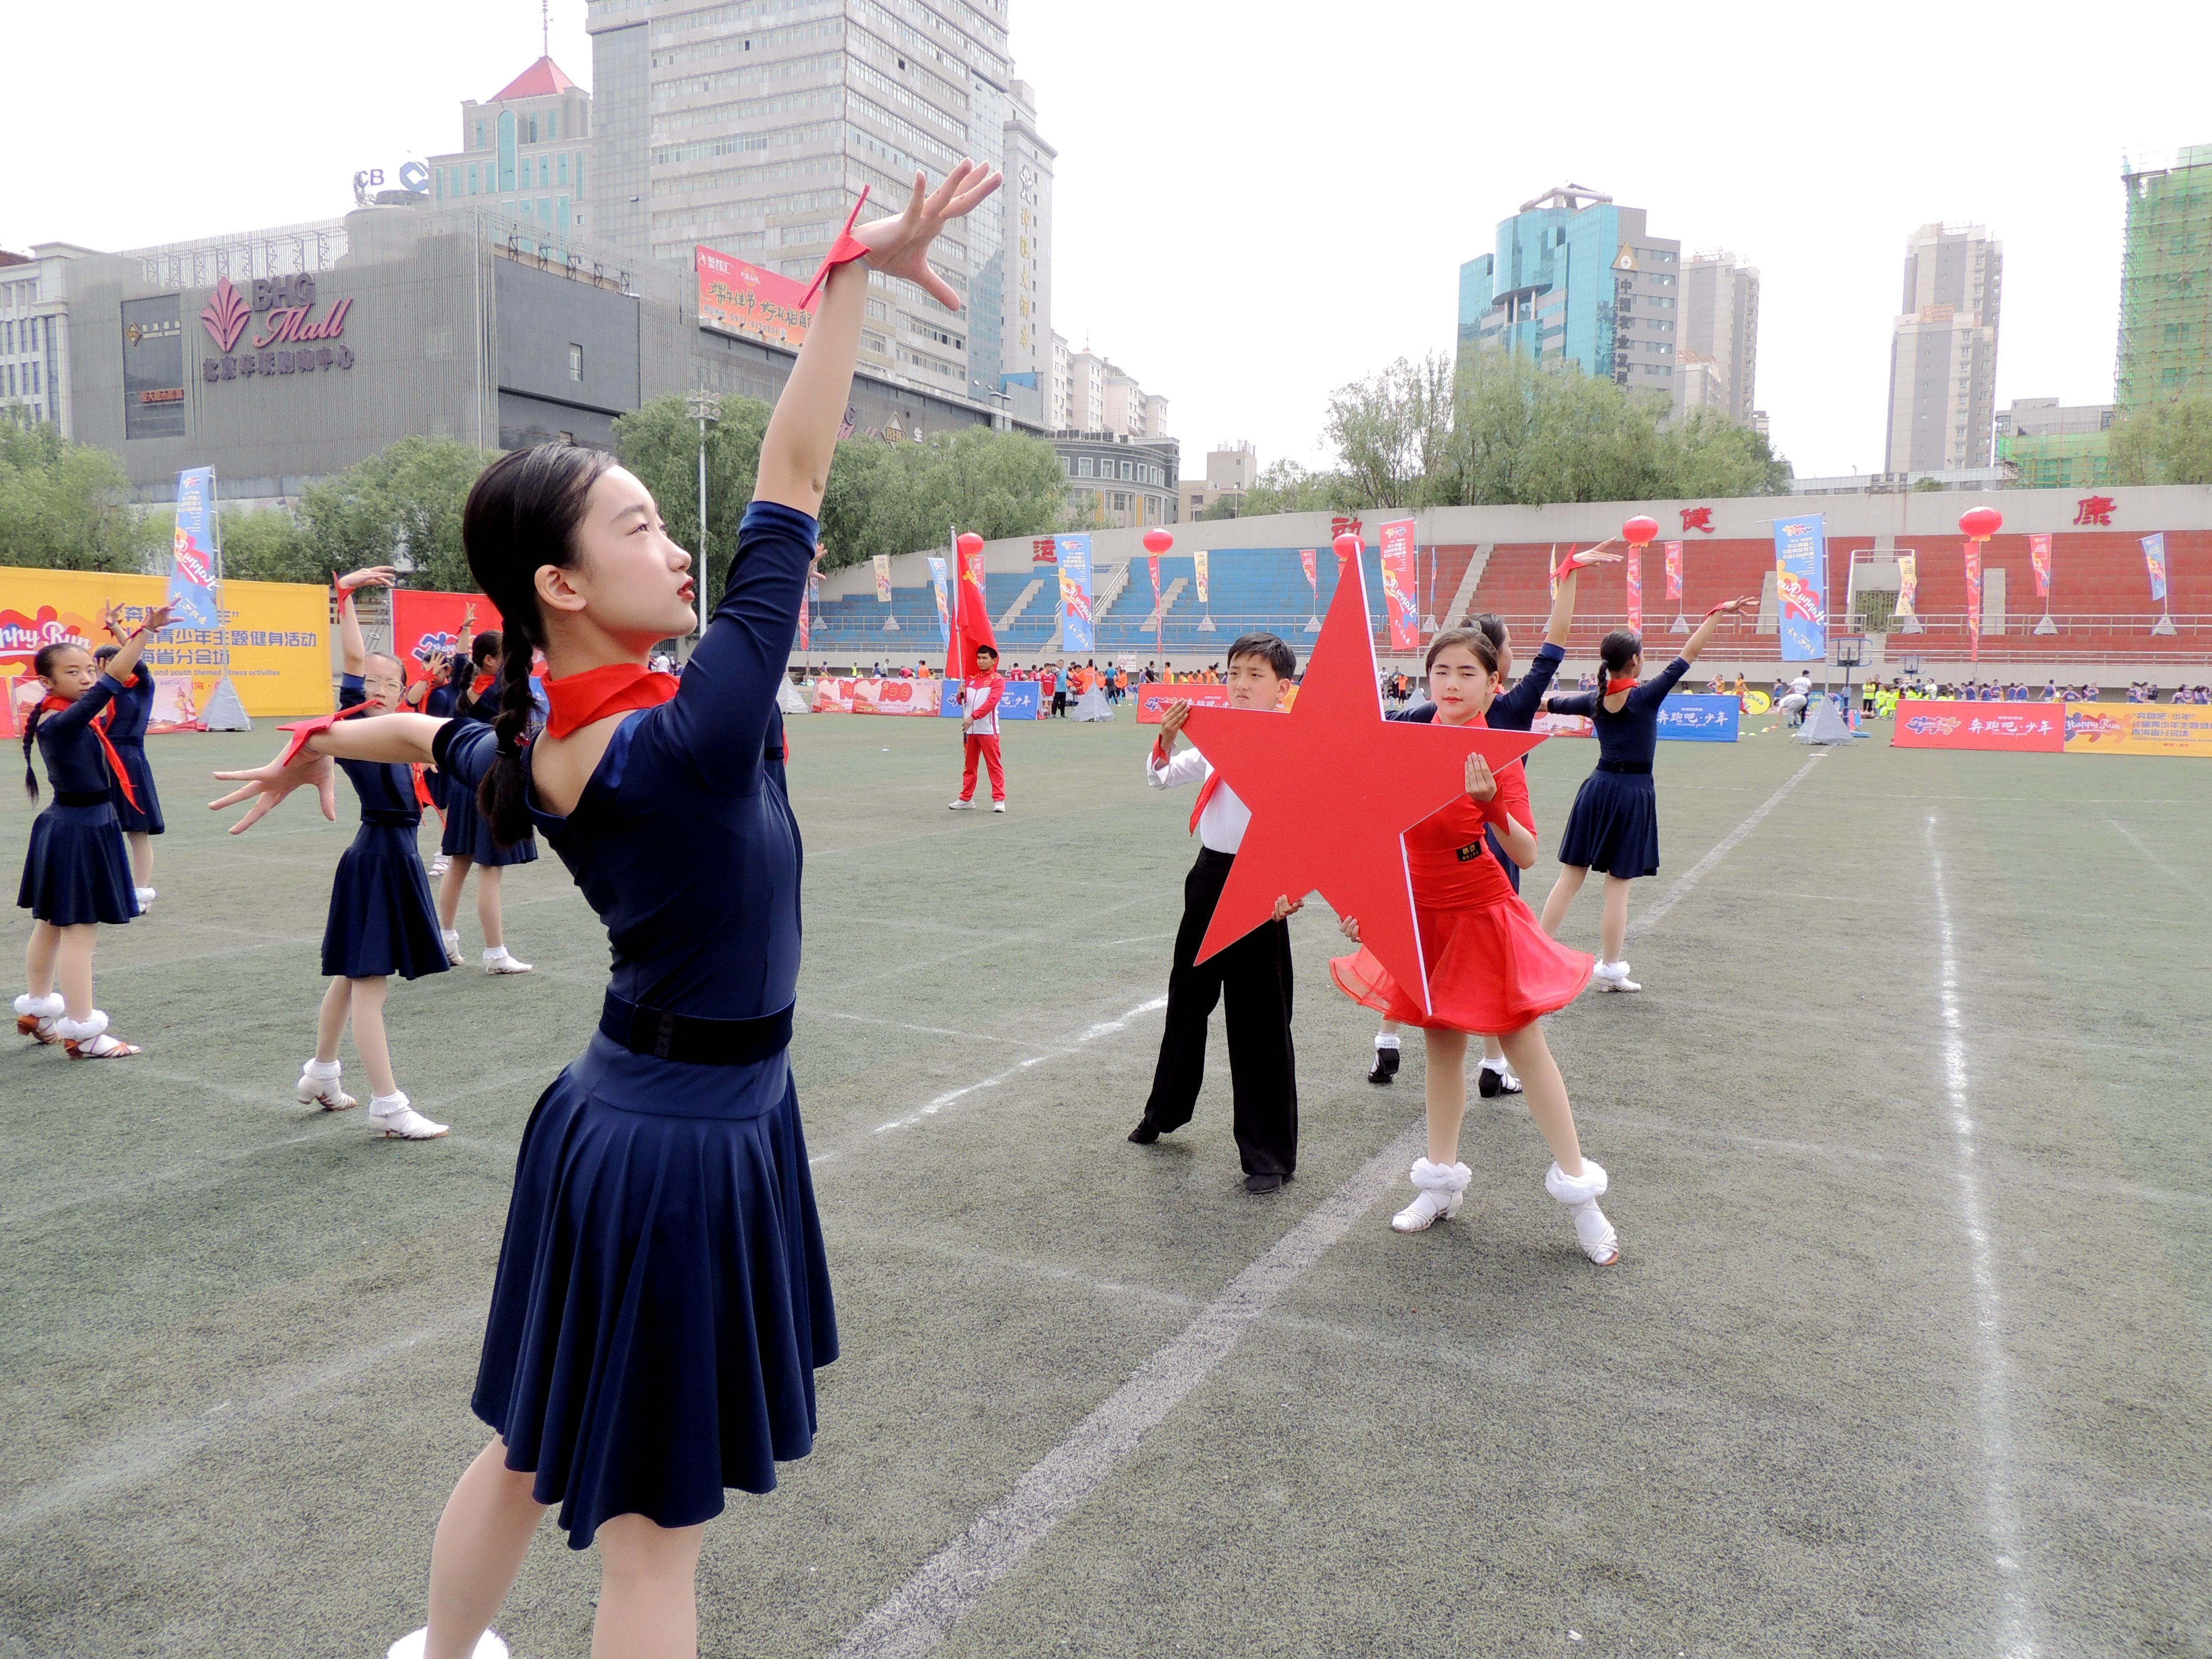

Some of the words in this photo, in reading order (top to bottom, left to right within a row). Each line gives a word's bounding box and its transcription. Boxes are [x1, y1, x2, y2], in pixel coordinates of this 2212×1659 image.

[252, 273, 315, 312] BHG
[253, 296, 353, 348] Mall
[1680, 506, 1715, 533] 健
[2073, 495, 2117, 526] 康
[42, 621, 92, 649] Run
[170, 669, 192, 677] youth
[1656, 709, 1729, 726] 奔跑吧·少年
[1967, 717, 2054, 735] 奔跑吧·少年
[2066, 719, 2099, 731] Happy
[2099, 718, 2120, 730] Run
